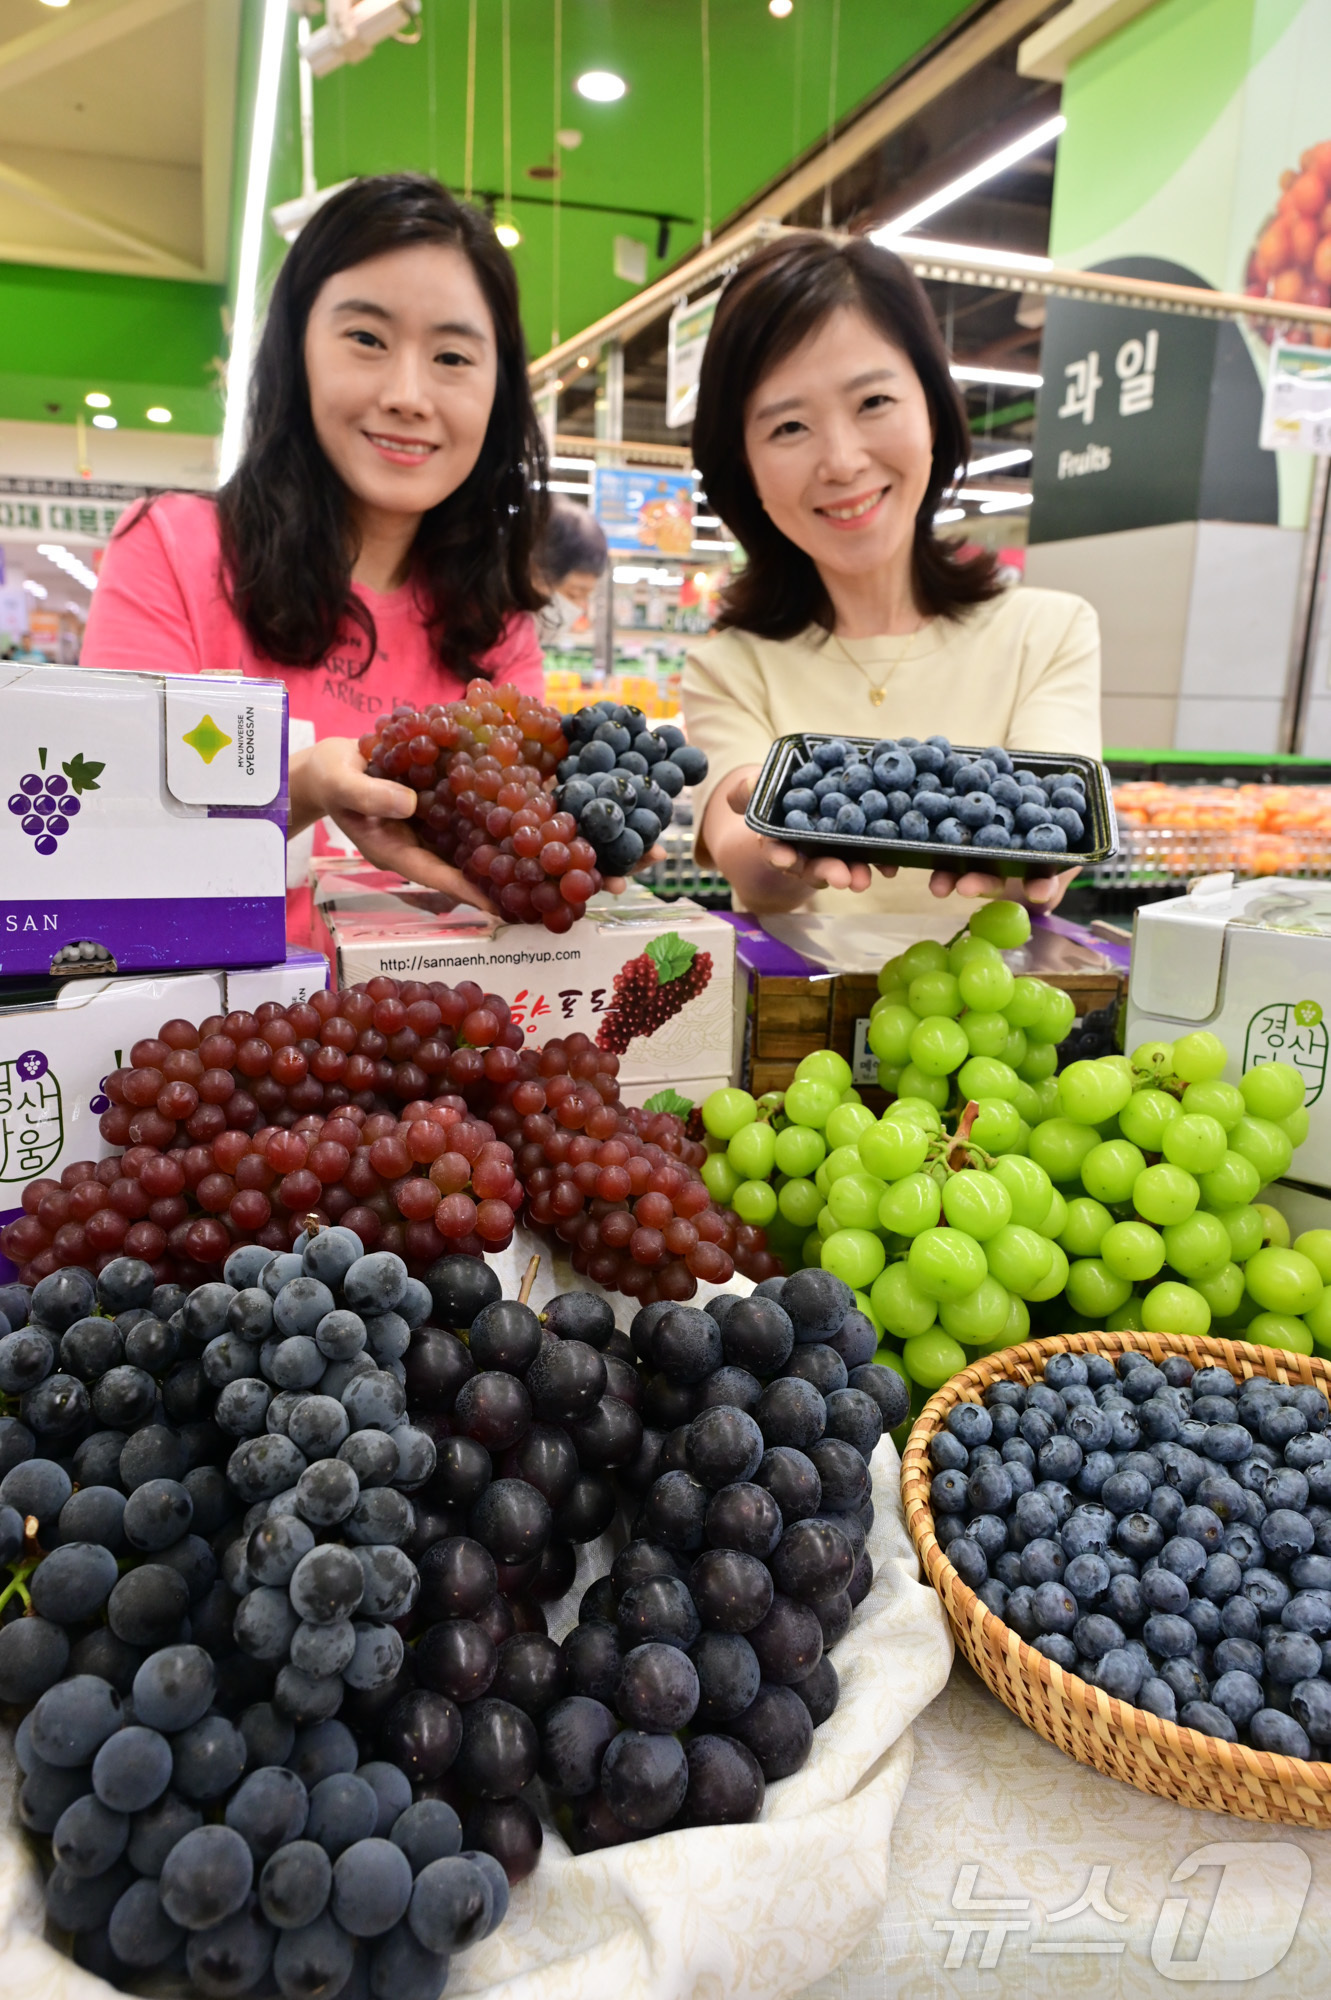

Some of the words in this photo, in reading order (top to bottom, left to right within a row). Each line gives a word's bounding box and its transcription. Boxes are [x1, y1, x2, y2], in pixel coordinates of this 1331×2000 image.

[1058, 329, 1160, 425] 과일
[1057, 443, 1112, 480] Fruits
[246, 706, 255, 776] GYEONGSAN
[237, 756, 244, 768] MY
[6, 914, 58, 932] SAN
[380, 949, 581, 972] http://sannaenh.nonghyup.com
